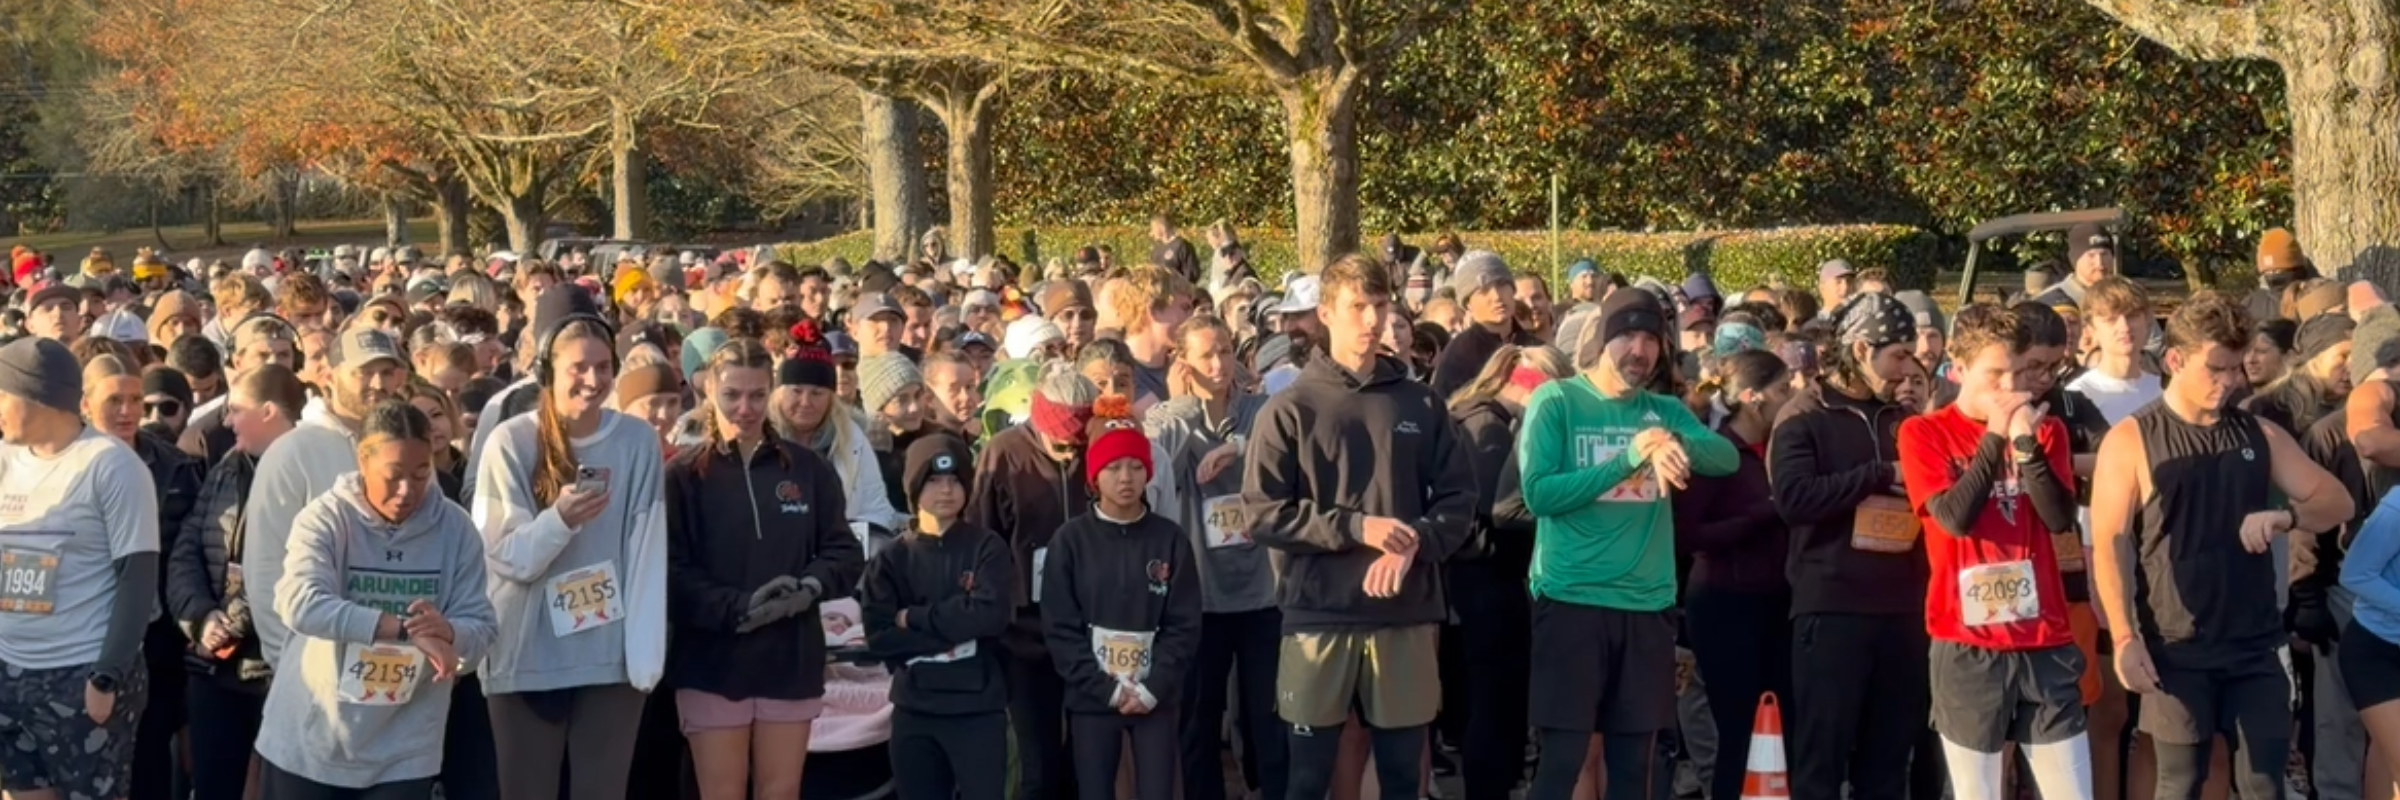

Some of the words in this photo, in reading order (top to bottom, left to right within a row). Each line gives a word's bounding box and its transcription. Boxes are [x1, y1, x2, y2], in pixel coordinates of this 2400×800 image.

[1207, 509, 1244, 527] 417
[5, 568, 46, 595] 1994
[1966, 577, 2031, 602] 42093
[553, 577, 617, 612] 42155
[1097, 645, 1150, 668] 41698
[349, 660, 417, 683] 42154
